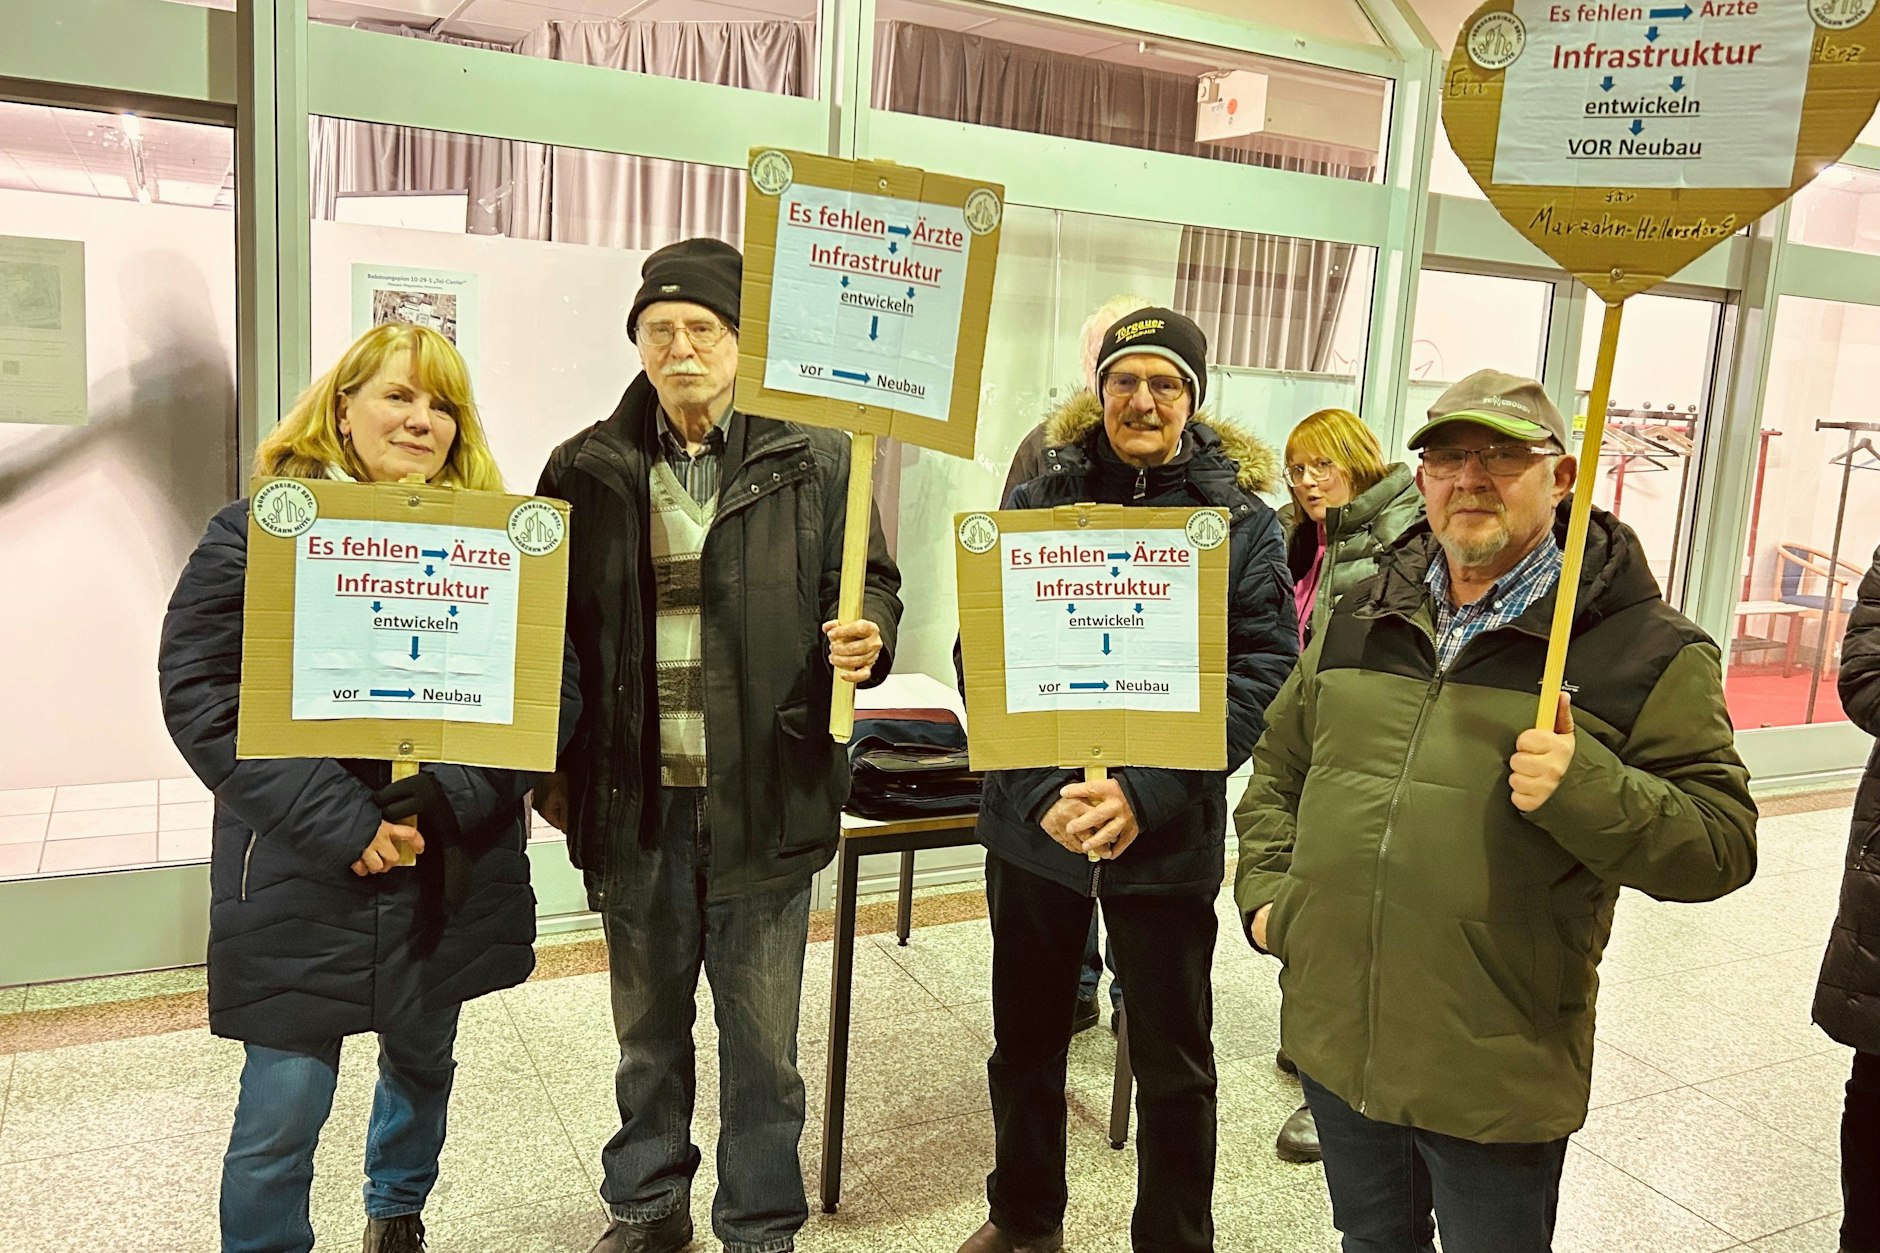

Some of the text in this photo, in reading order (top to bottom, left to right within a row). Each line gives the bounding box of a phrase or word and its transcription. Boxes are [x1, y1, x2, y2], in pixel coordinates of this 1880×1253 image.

[1549, 5, 1570, 22] Es
[1577, 3, 1643, 22] fehlen
[1552, 40, 1762, 70] Infrastruktur
[1813, 36, 1862, 62] Herz
[1450, 67, 1484, 97] Ein
[1584, 97, 1701, 116] entwickeln
[1567, 138, 1702, 157] VOR Neubau
[789, 202, 963, 247] Es fehlen Ärzte
[810, 244, 943, 284] Infrastruktur
[841, 291, 914, 314] entwickeln
[800, 363, 926, 397] vor Neubau
[261, 516, 311, 534] MARZAHN MITTE
[308, 536, 511, 566] Es fehlen Ärzte
[1011, 541, 1189, 566] Es fehlen Ärzte
[337, 574, 489, 600] Infrastruktur
[1036, 578, 1171, 597] Infrastruktur
[373, 616, 458, 631] entwickeln
[1069, 614, 1144, 627] entwickeln
[333, 688, 482, 704] vor Neubau
[1038, 679, 1169, 693] vor Neubau
